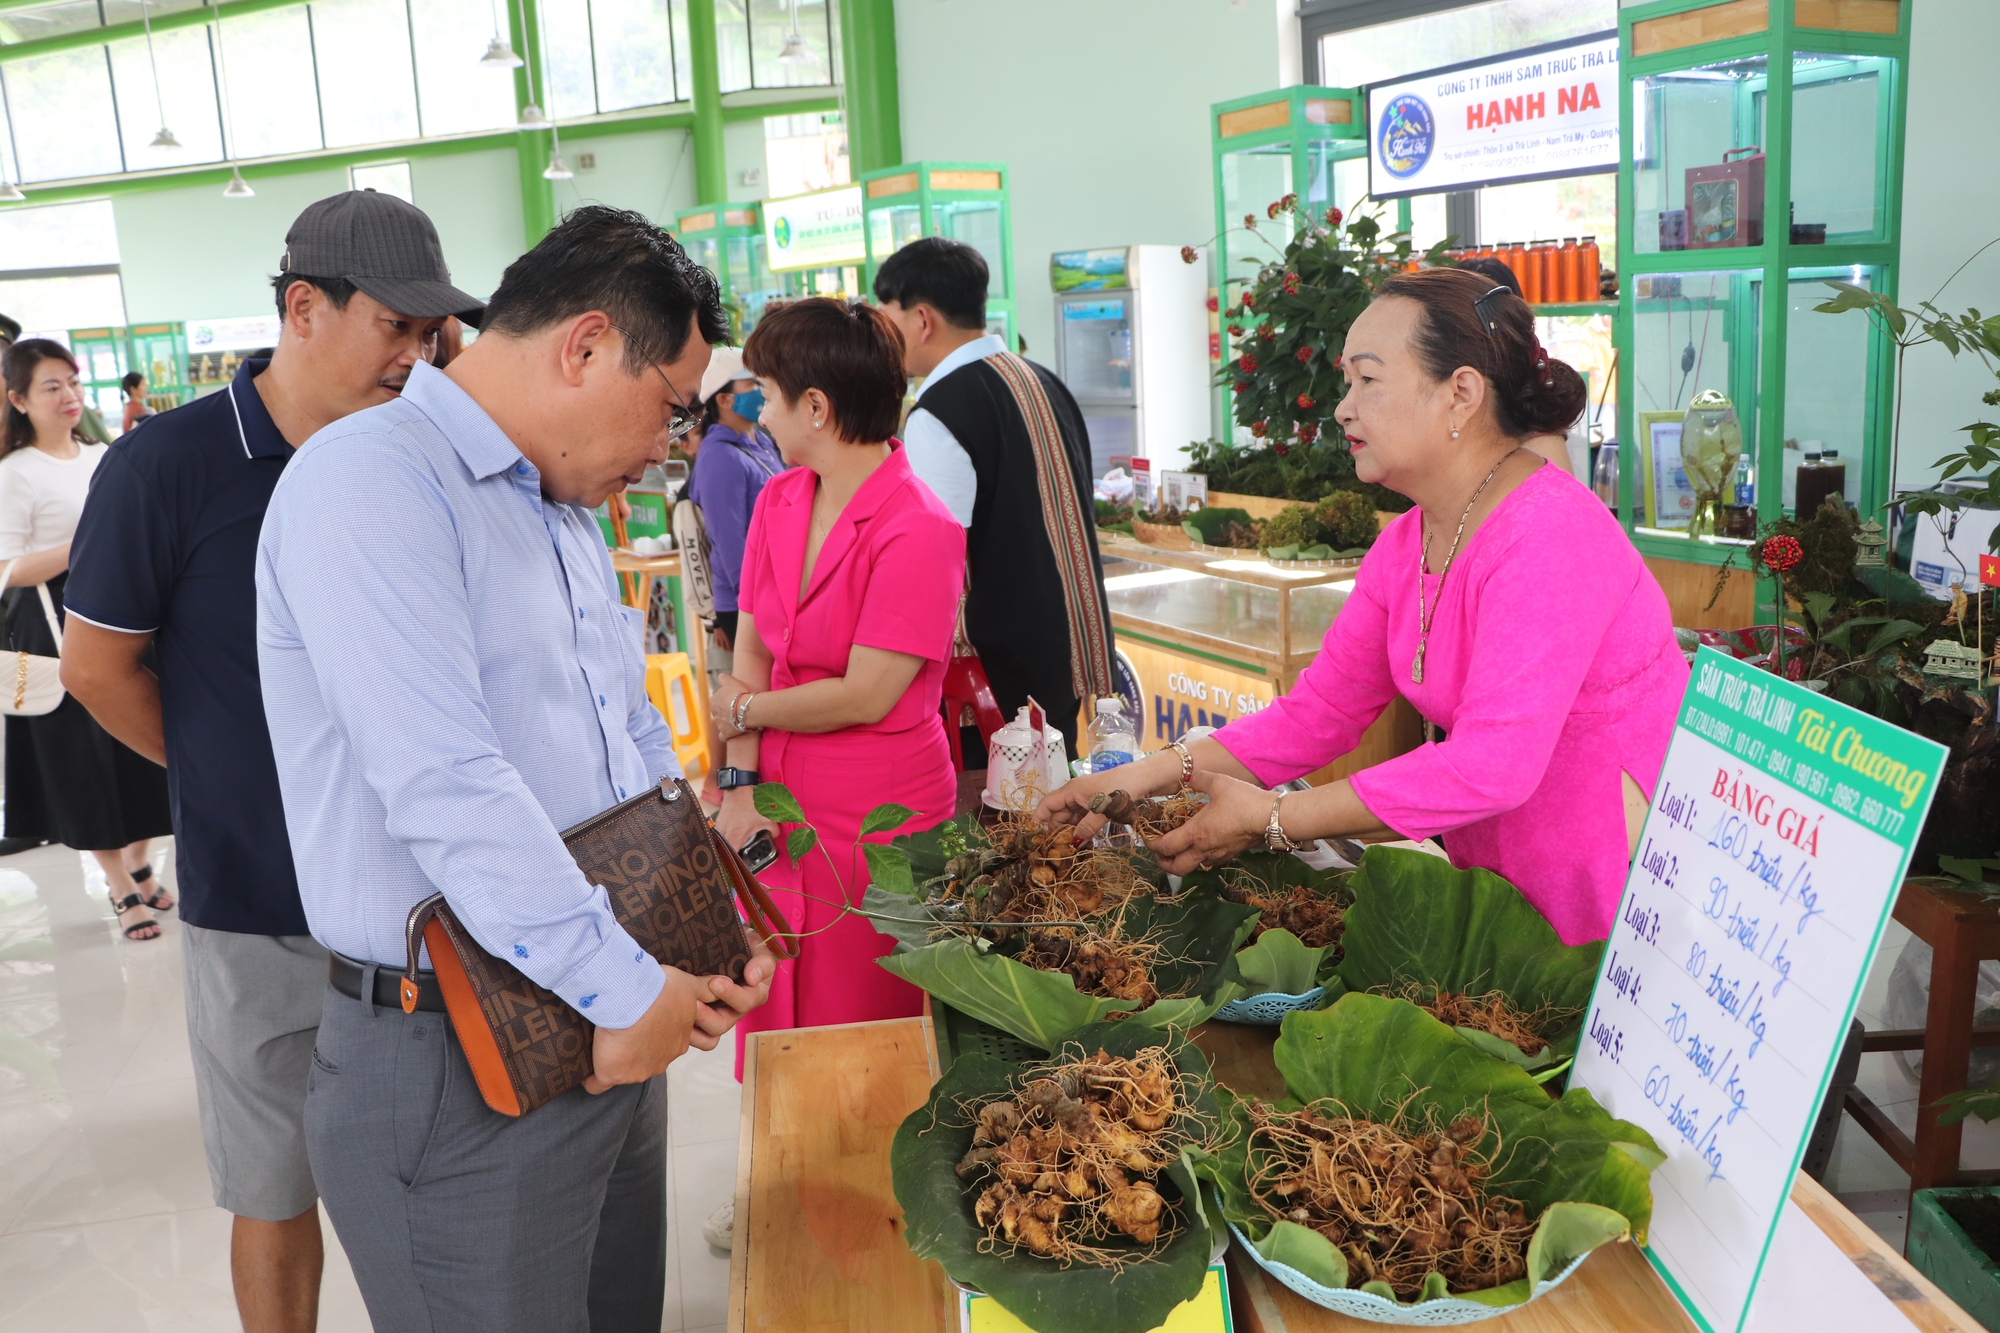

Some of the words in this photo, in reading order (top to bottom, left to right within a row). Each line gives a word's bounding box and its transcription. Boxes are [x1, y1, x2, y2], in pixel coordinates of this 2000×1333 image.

[1466, 91, 1545, 133] HẠNH
[1557, 81, 1601, 116] NA
[1485, 70, 1513, 88] TNHH
[686, 538, 704, 587] MOVE
[1168, 671, 1208, 701] CÔNG
[1211, 686, 1233, 709] TY
[1696, 659, 1723, 700] SÂM
[1718, 672, 1749, 712] TRÚC
[1743, 683, 1769, 722] TRÀ
[1763, 693, 1797, 735] LINH
[1658, 781, 1688, 829] Loại
[1683, 798, 1698, 832] 1:
[1708, 810, 1748, 859] 160
[1710, 767, 1775, 826] BẢNG
[1776, 806, 1825, 858] GIÁ
[1880, 806, 1906, 837] 777
[1640, 837, 1670, 885] Loại
[1664, 855, 1679, 889] 2:
[1702, 876, 1728, 919] 90
[1623, 892, 1652, 941] Loại
[1645, 912, 1661, 948] 3:
[1685, 941, 1707, 978] 80
[1606, 950, 1634, 999] Loại
[1629, 973, 1642, 1006] 4:
[1664, 1002, 1687, 1044] 70
[1589, 1007, 1617, 1057] Loại
[1610, 1031, 1624, 1065] 5:
[1643, 1065, 1670, 1107] 60
